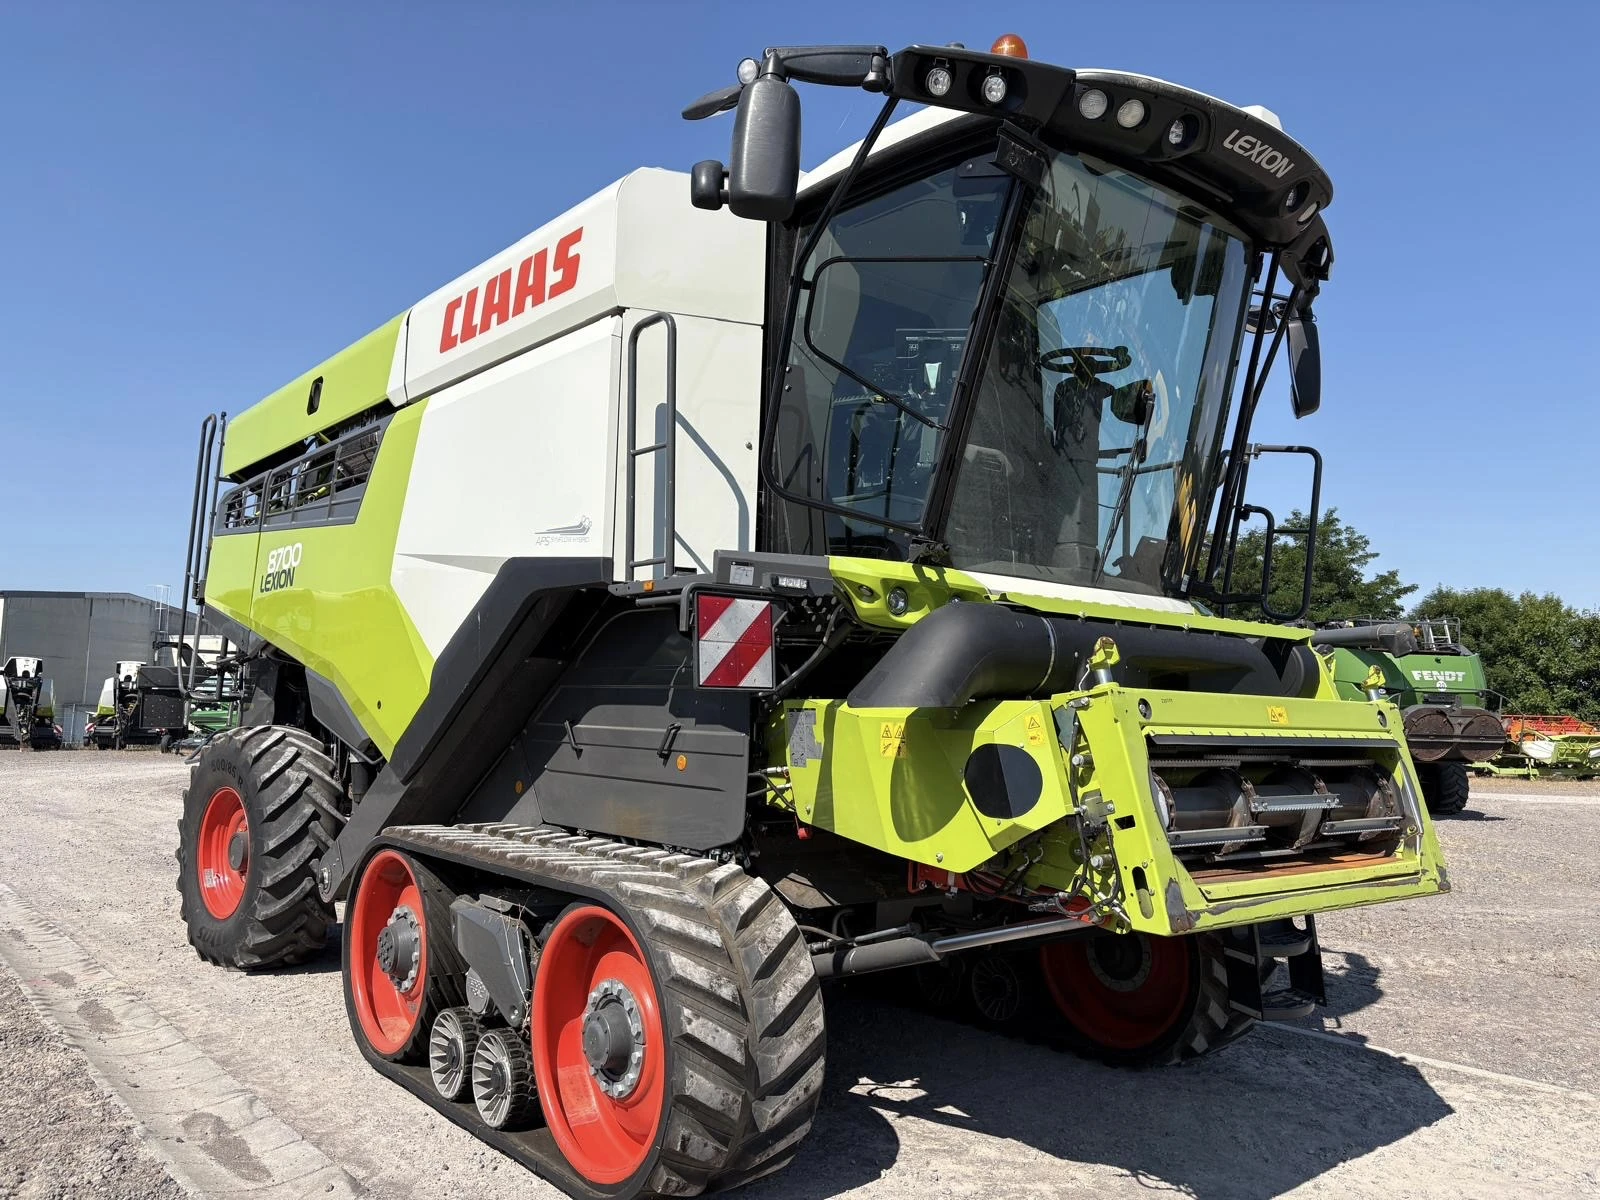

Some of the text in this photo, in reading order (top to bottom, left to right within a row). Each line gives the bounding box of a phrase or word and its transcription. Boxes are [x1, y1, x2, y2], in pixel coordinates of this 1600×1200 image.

[1222, 128, 1295, 178] LEXION
[439, 226, 584, 354] CLAAS
[267, 542, 303, 575] 8700
[260, 566, 296, 593] LEXION
[1411, 670, 1466, 682] FENDT
